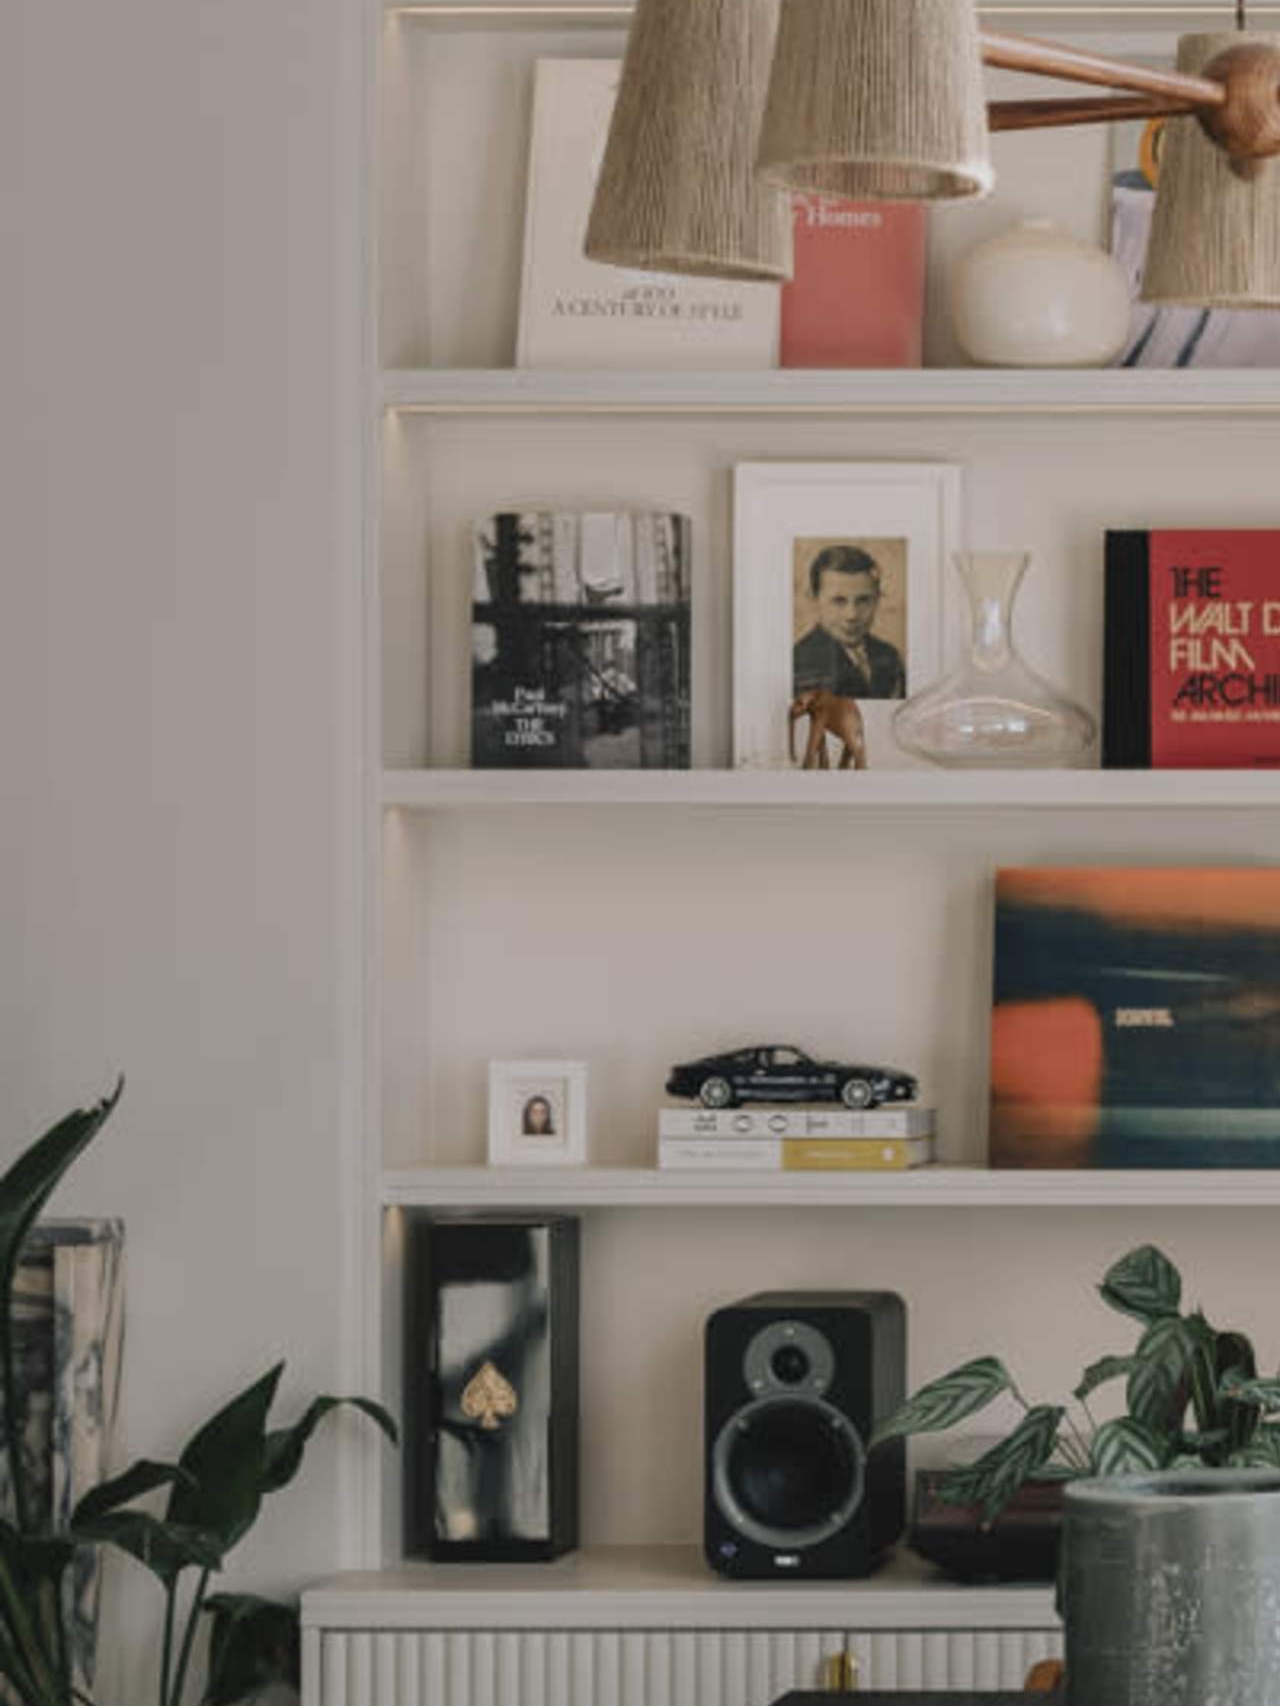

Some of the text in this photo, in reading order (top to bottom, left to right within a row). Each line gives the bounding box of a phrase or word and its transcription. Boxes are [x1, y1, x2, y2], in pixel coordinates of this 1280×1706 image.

[1170, 566, 1222, 598] THE
[1169, 600, 1253, 635] WALT
[1169, 638, 1256, 672] FILM
